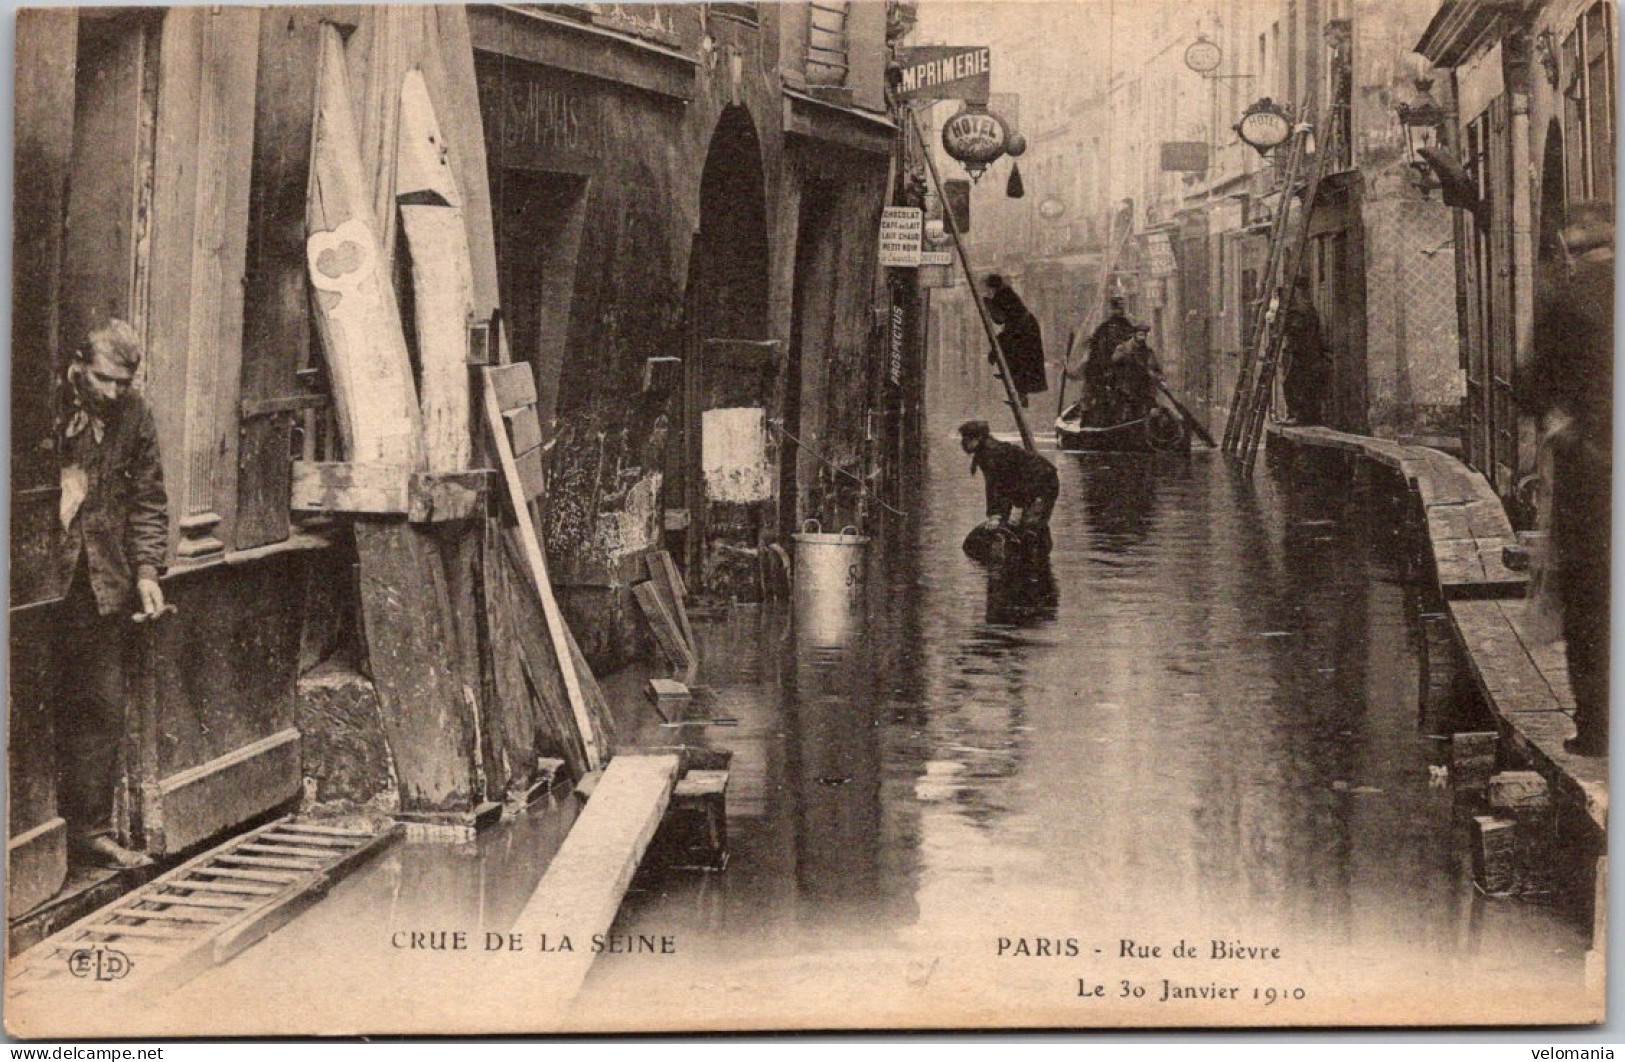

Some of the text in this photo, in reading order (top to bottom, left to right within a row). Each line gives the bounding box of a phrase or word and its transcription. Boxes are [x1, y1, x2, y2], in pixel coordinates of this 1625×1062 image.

[951, 117, 997, 139] HOTEL
[883, 210, 921, 219] CHOCOLAT
[906, 221, 921, 229] LAIT
[881, 243, 901, 251] PETIT
[890, 304, 904, 387] PROSPECTUS
